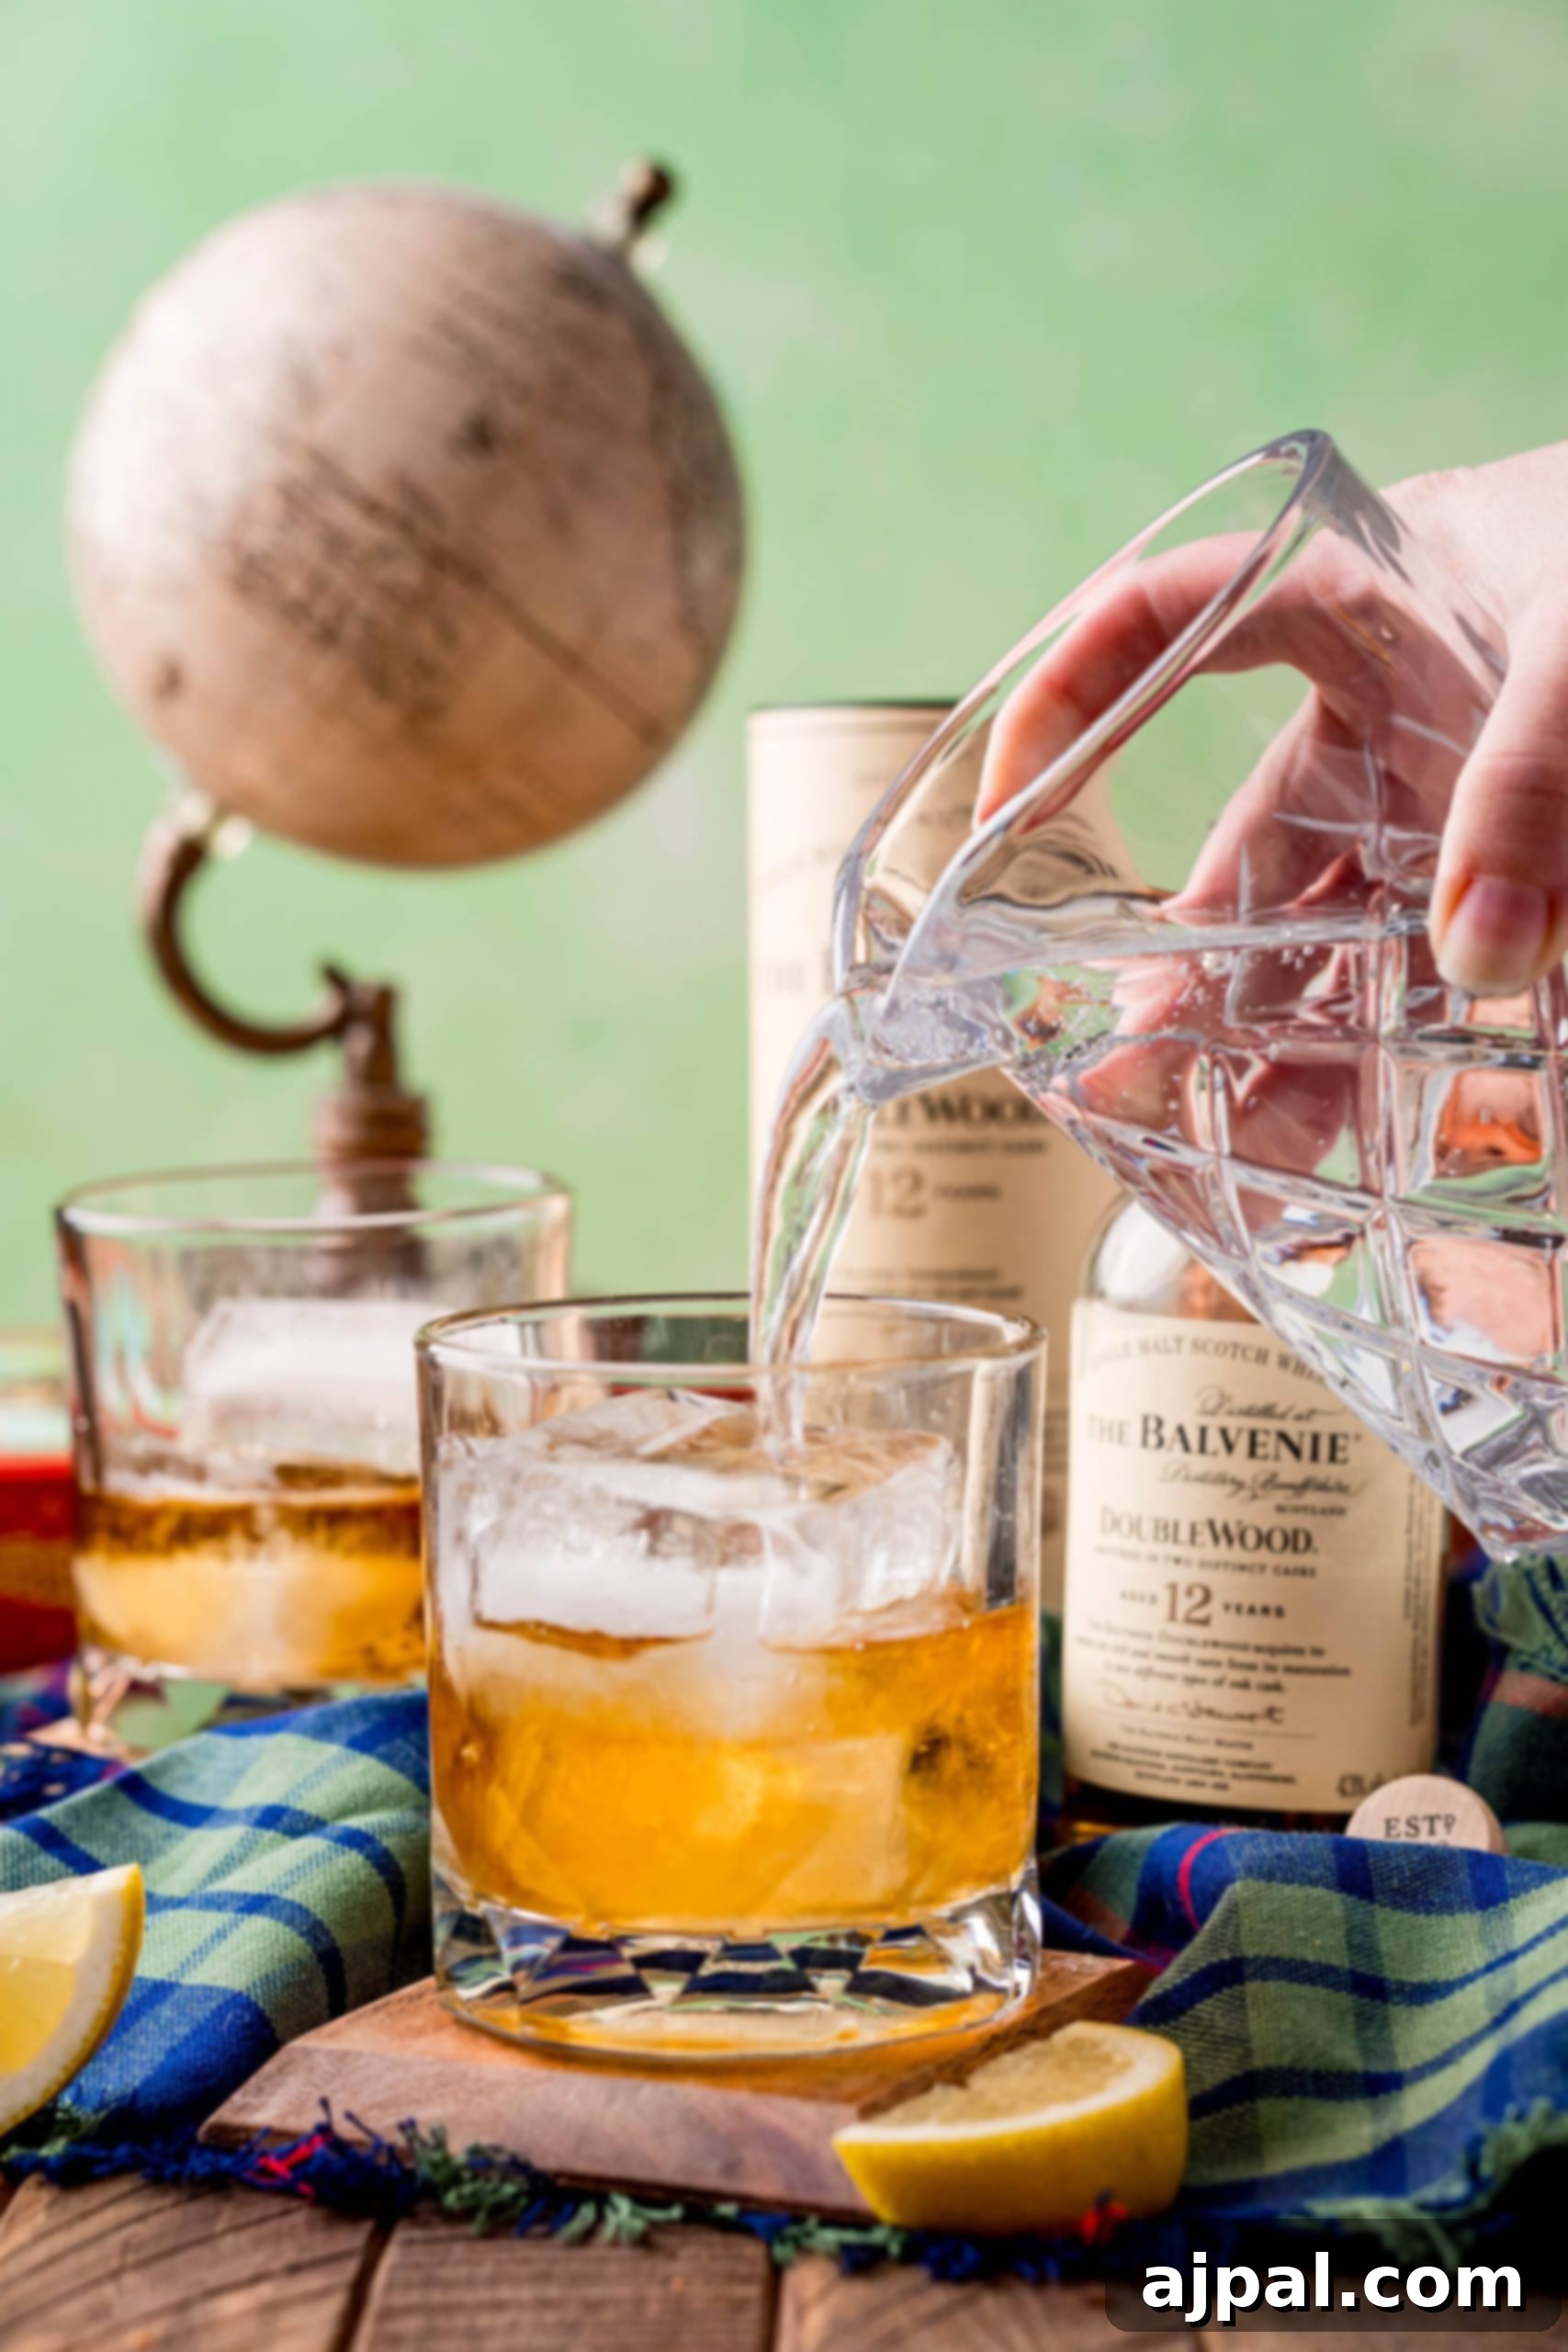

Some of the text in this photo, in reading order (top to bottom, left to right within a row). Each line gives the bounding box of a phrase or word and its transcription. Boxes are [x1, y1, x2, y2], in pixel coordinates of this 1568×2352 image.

[1136, 1336, 1184, 1356] MALT
[1190, 1337, 1270, 1367] SCOTCH
[1087, 1412, 1351, 1465] THE BALVENIE
[1274, 1502, 1348, 1518] SCOTLAND
[1163, 1554, 1193, 1568] TWO
[1198, 1557, 1268, 1577] DISTINCT
[1271, 1563, 1318, 1578] CASKS
[1165, 1580, 1213, 1627] 12
[1222, 1602, 1287, 1620] YEARS
